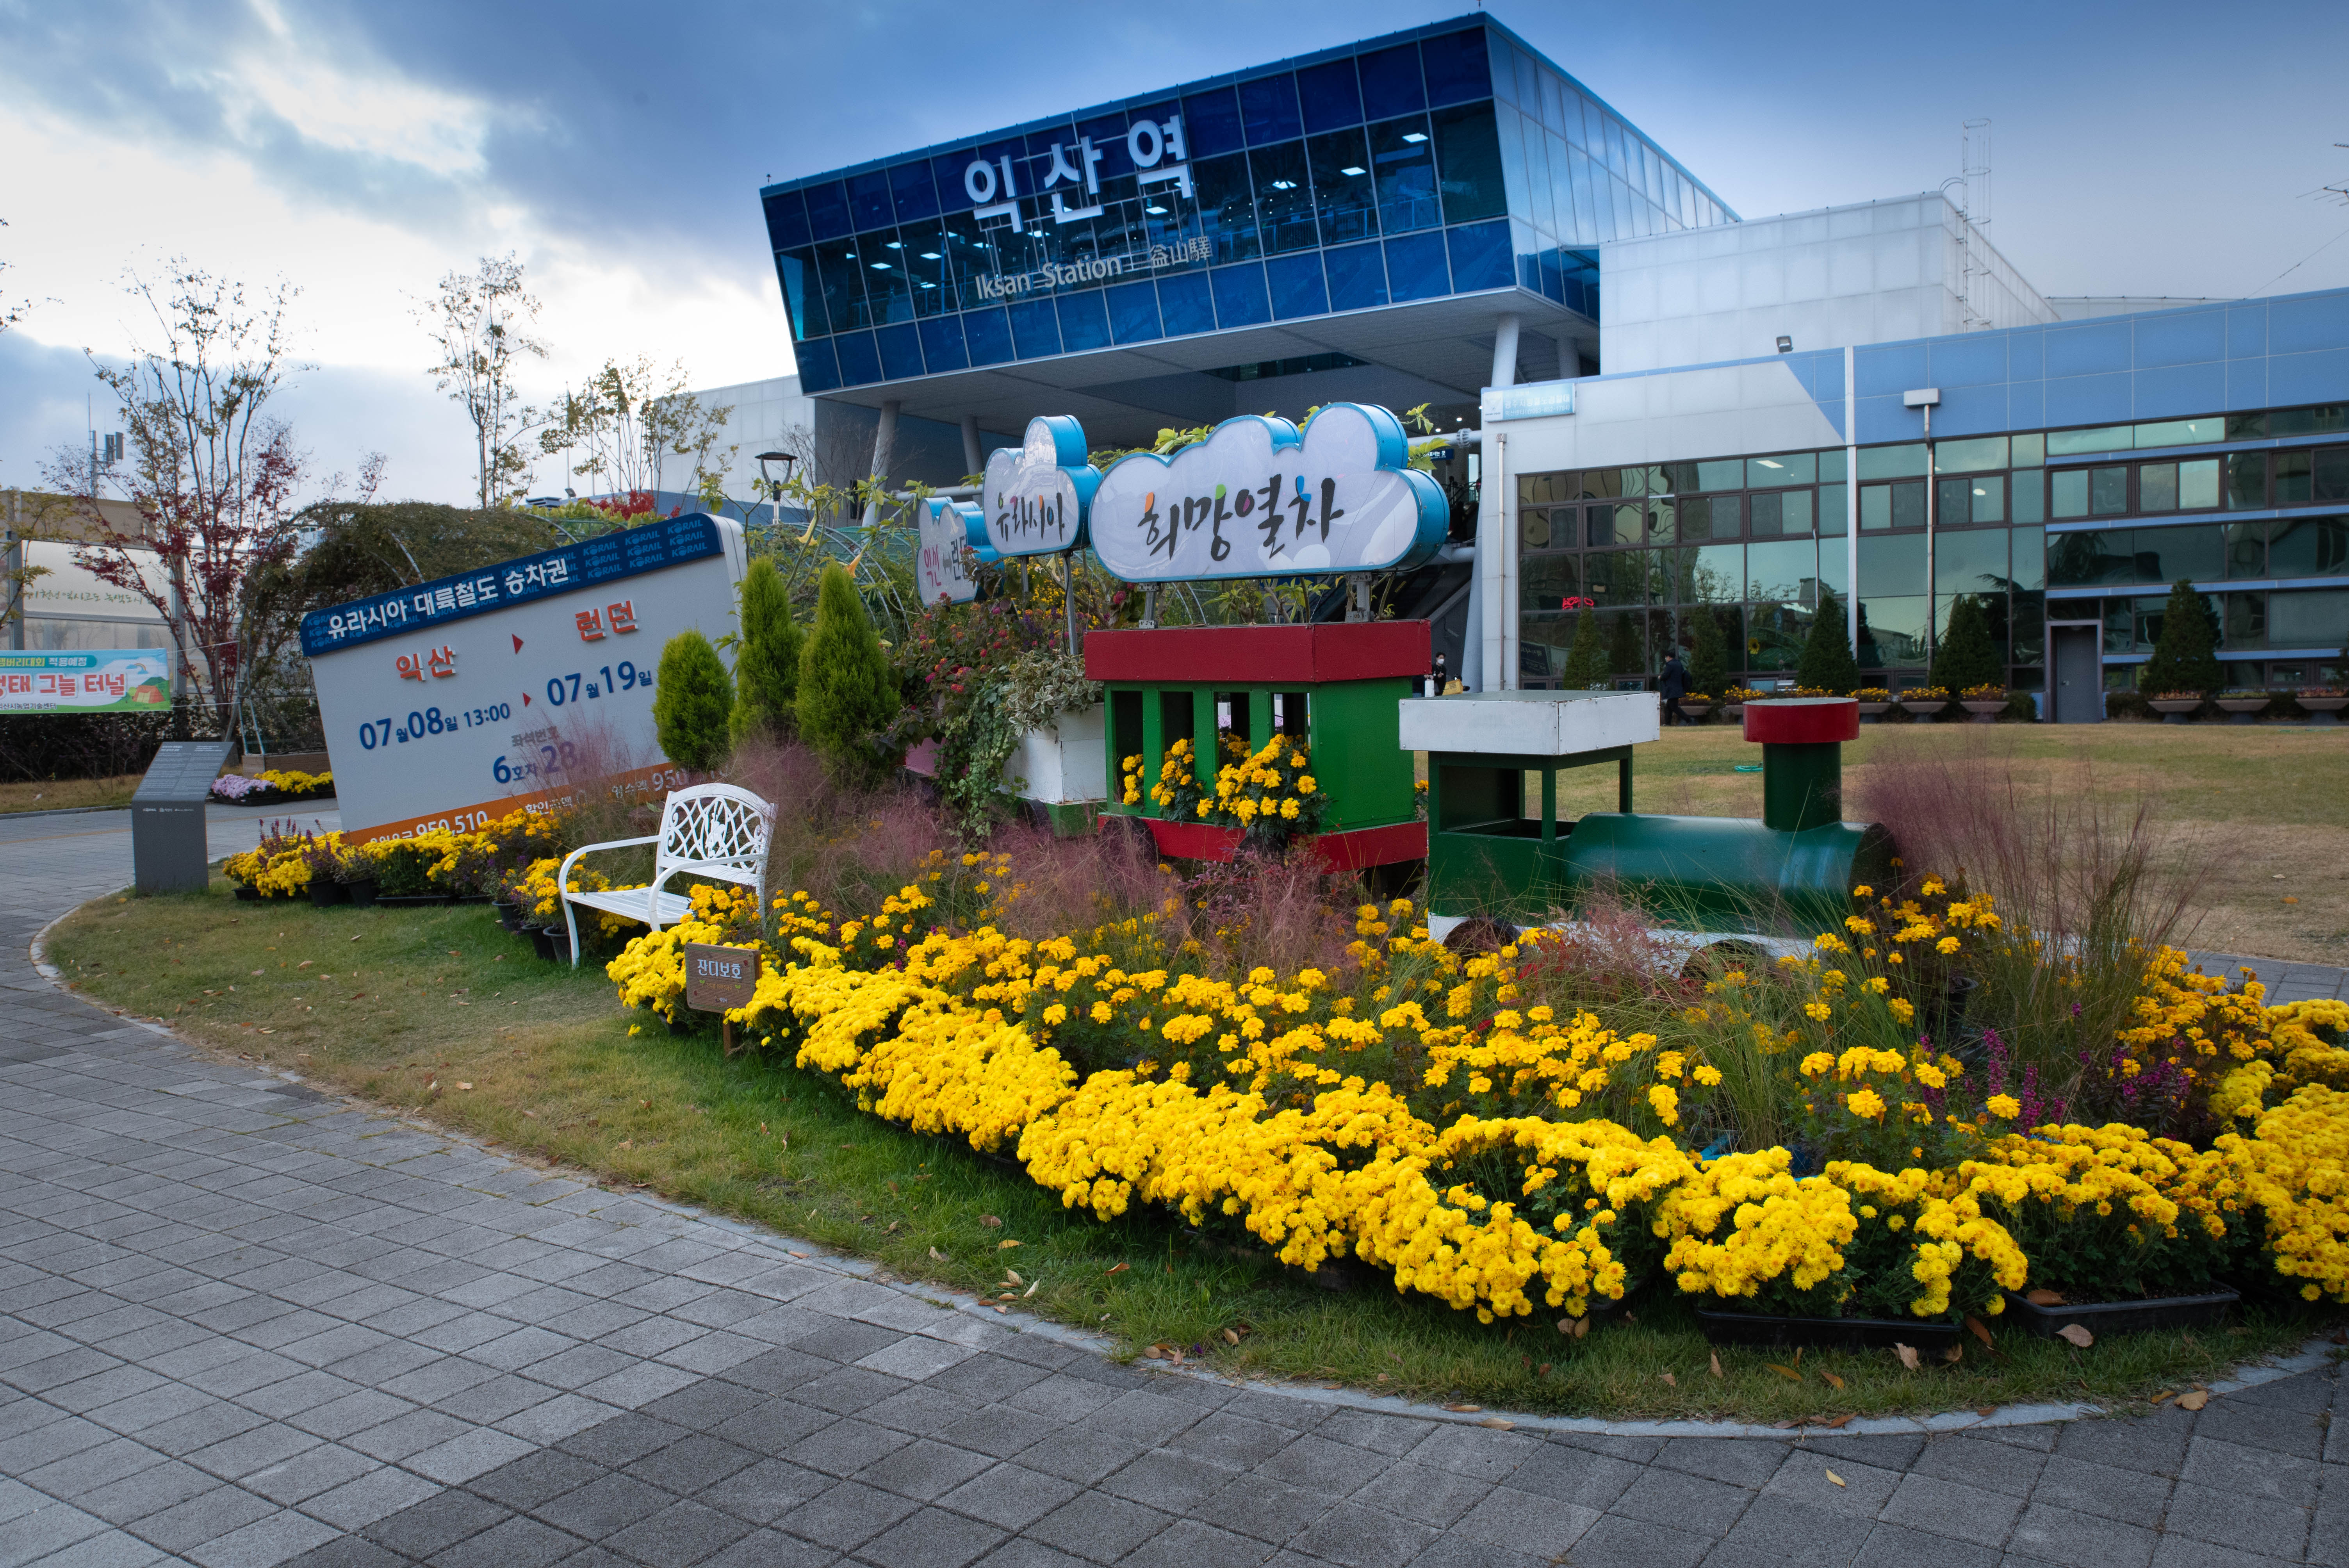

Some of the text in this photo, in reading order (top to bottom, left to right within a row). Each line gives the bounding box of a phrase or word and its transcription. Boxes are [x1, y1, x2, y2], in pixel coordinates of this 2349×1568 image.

[964, 114, 1195, 233] 익산역
[975, 255, 1123, 300] Iksan Station
[996, 492, 1065, 542] 유라시아
[1138, 474, 1344, 561] 희망열차
[328, 558, 568, 640] 유라시아 대륙철도 승차권
[575, 600, 638, 641] 런던
[49, 657, 87, 667] 적용예정
[396, 645, 456, 682] 익산
[0, 674, 125, 697] 태 그늘 터널
[463, 703, 510, 729] 13:00
[697, 959, 741, 979] 잔디보호
